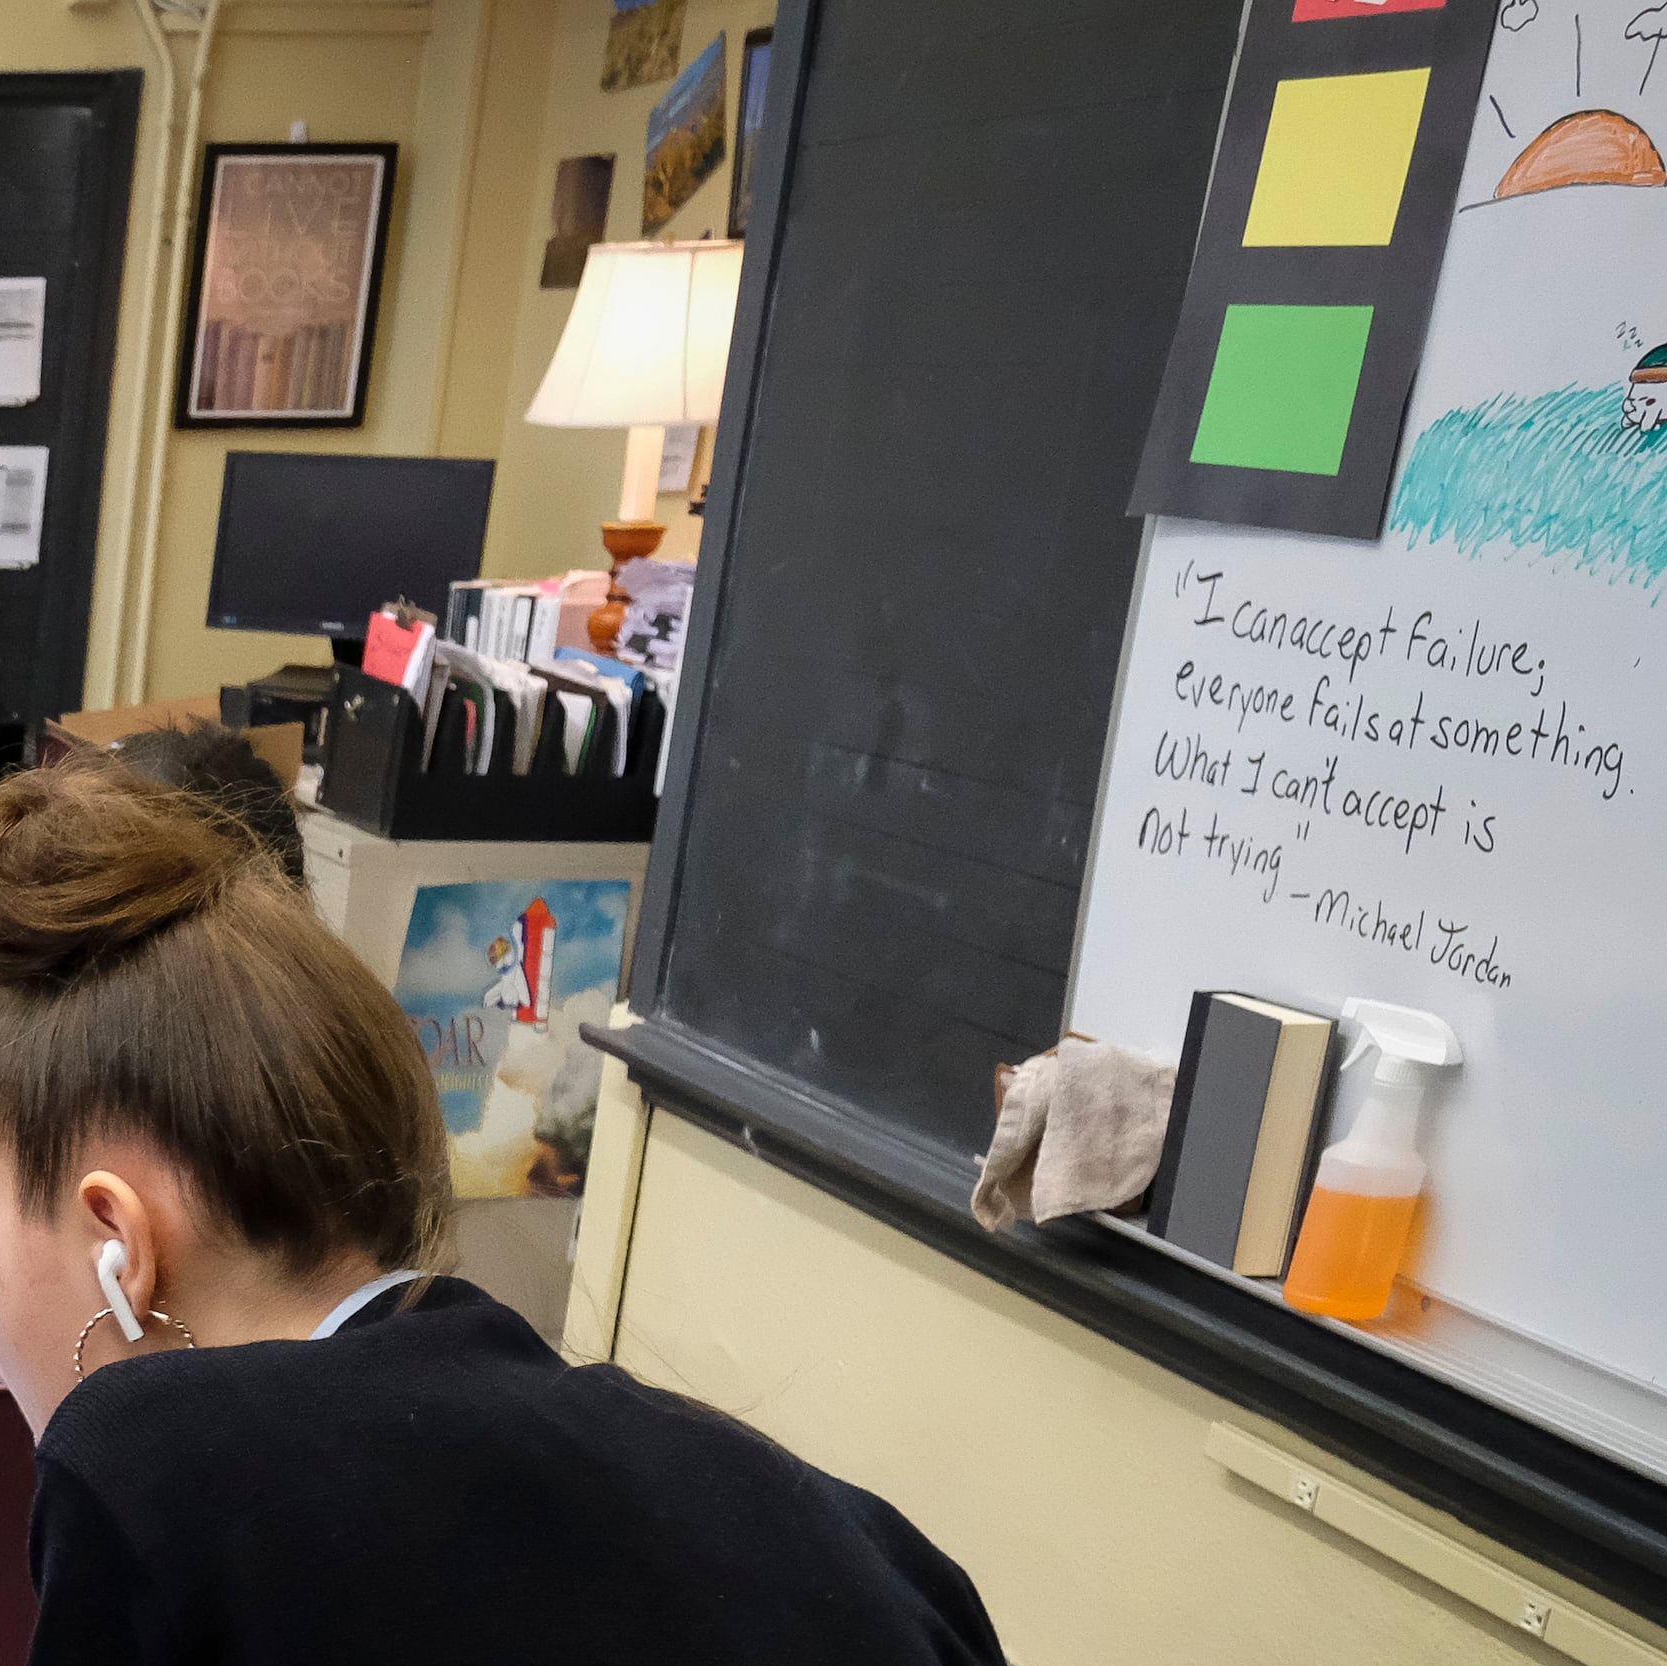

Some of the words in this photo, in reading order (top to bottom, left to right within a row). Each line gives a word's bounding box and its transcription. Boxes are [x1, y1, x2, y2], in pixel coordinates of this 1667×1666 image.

[1174, 659, 1296, 734] everyone
[1154, 730, 1232, 787] What
[1342, 784, 1447, 855] accept
[1463, 800, 1497, 854] is
[1430, 918, 1514, 991] Jordan
[407, 1013, 486, 1069] OAR
